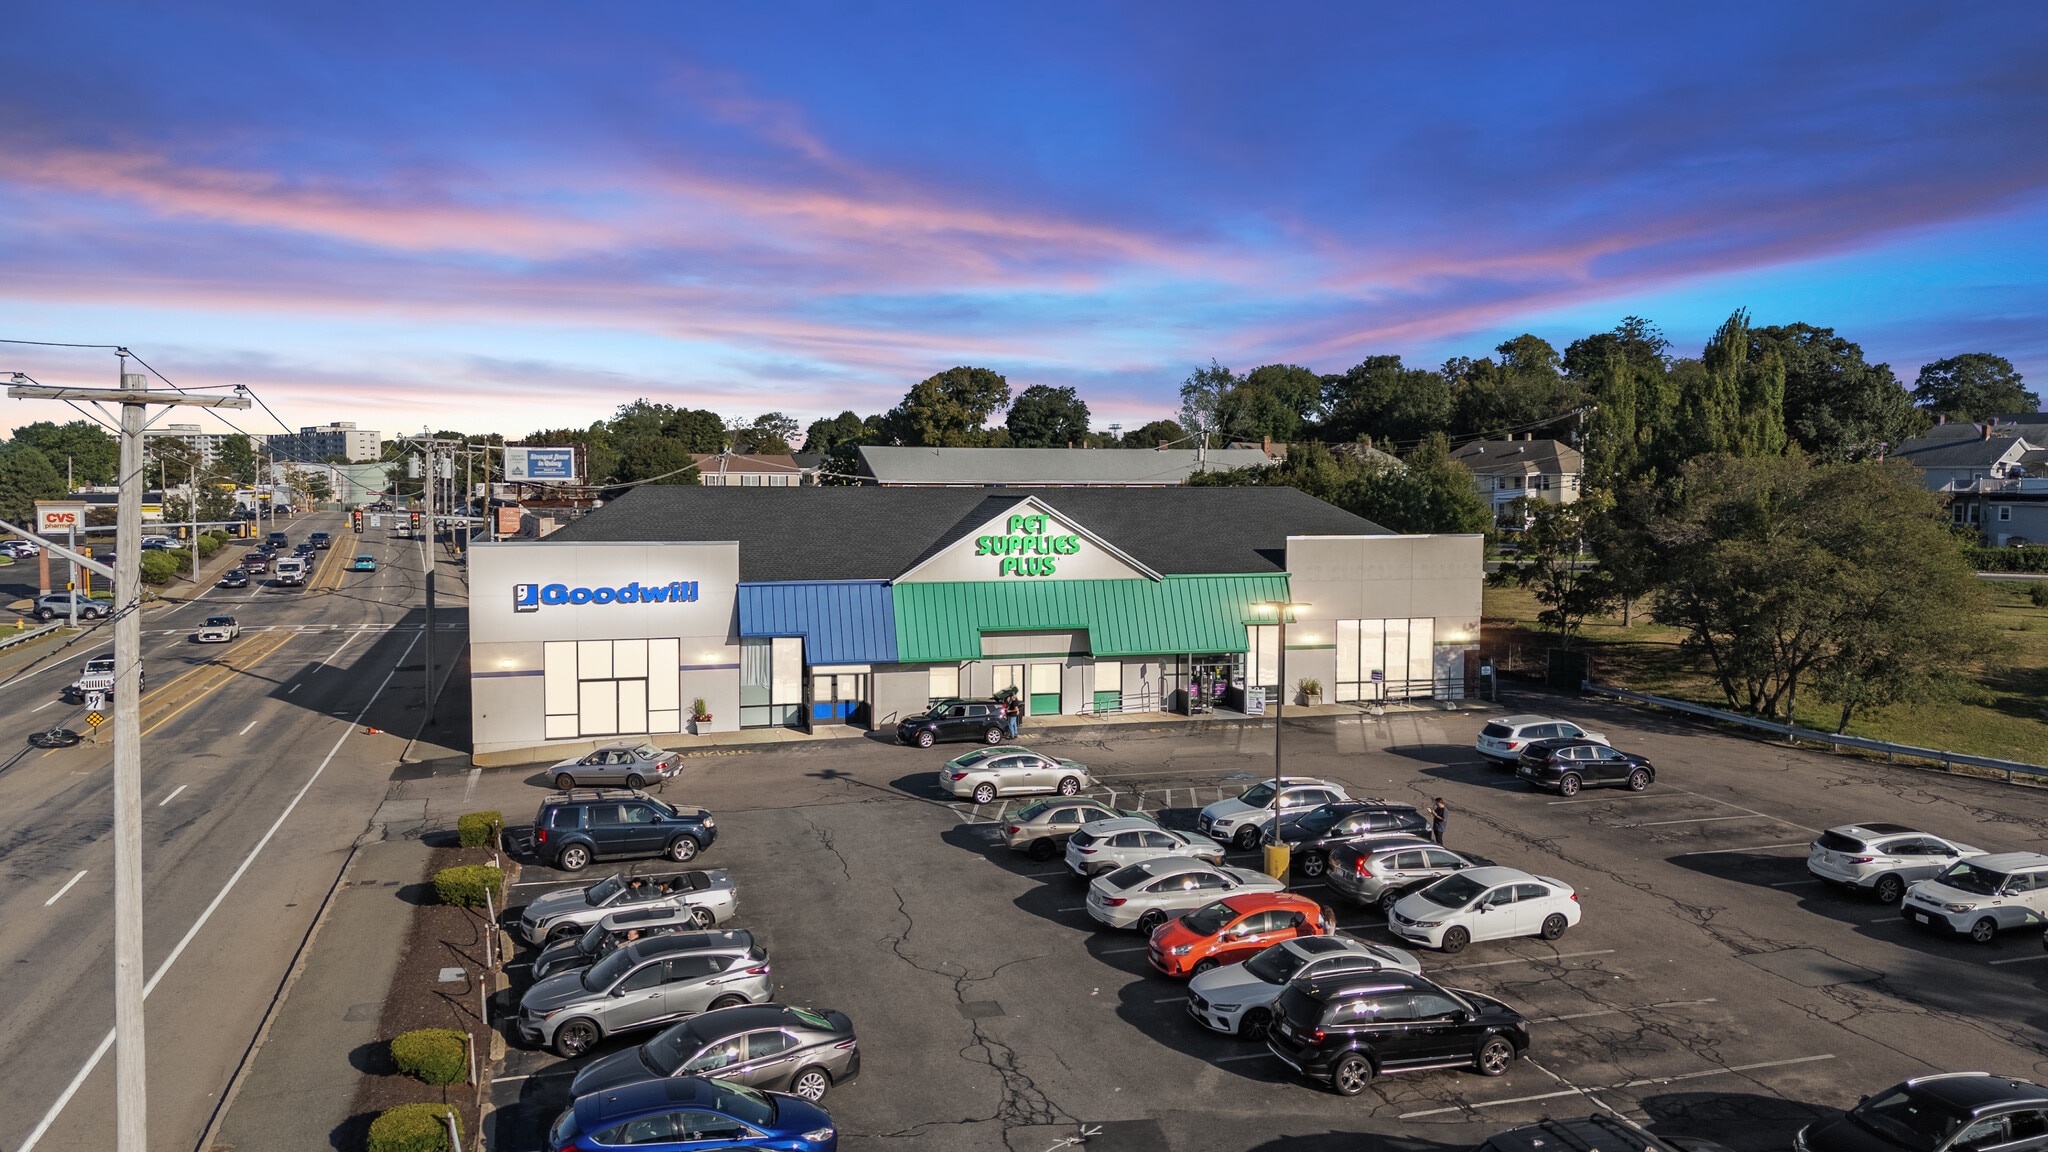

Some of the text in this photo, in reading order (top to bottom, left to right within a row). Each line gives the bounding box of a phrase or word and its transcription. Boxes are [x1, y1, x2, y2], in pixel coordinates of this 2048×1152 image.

[46, 513, 75, 523] CVS
[1007, 514, 1050, 534] PET
[976, 535, 1081, 555] SUPPLIES
[1000, 557, 1056, 576] PLUS
[540, 581, 699, 605] Goodwill
